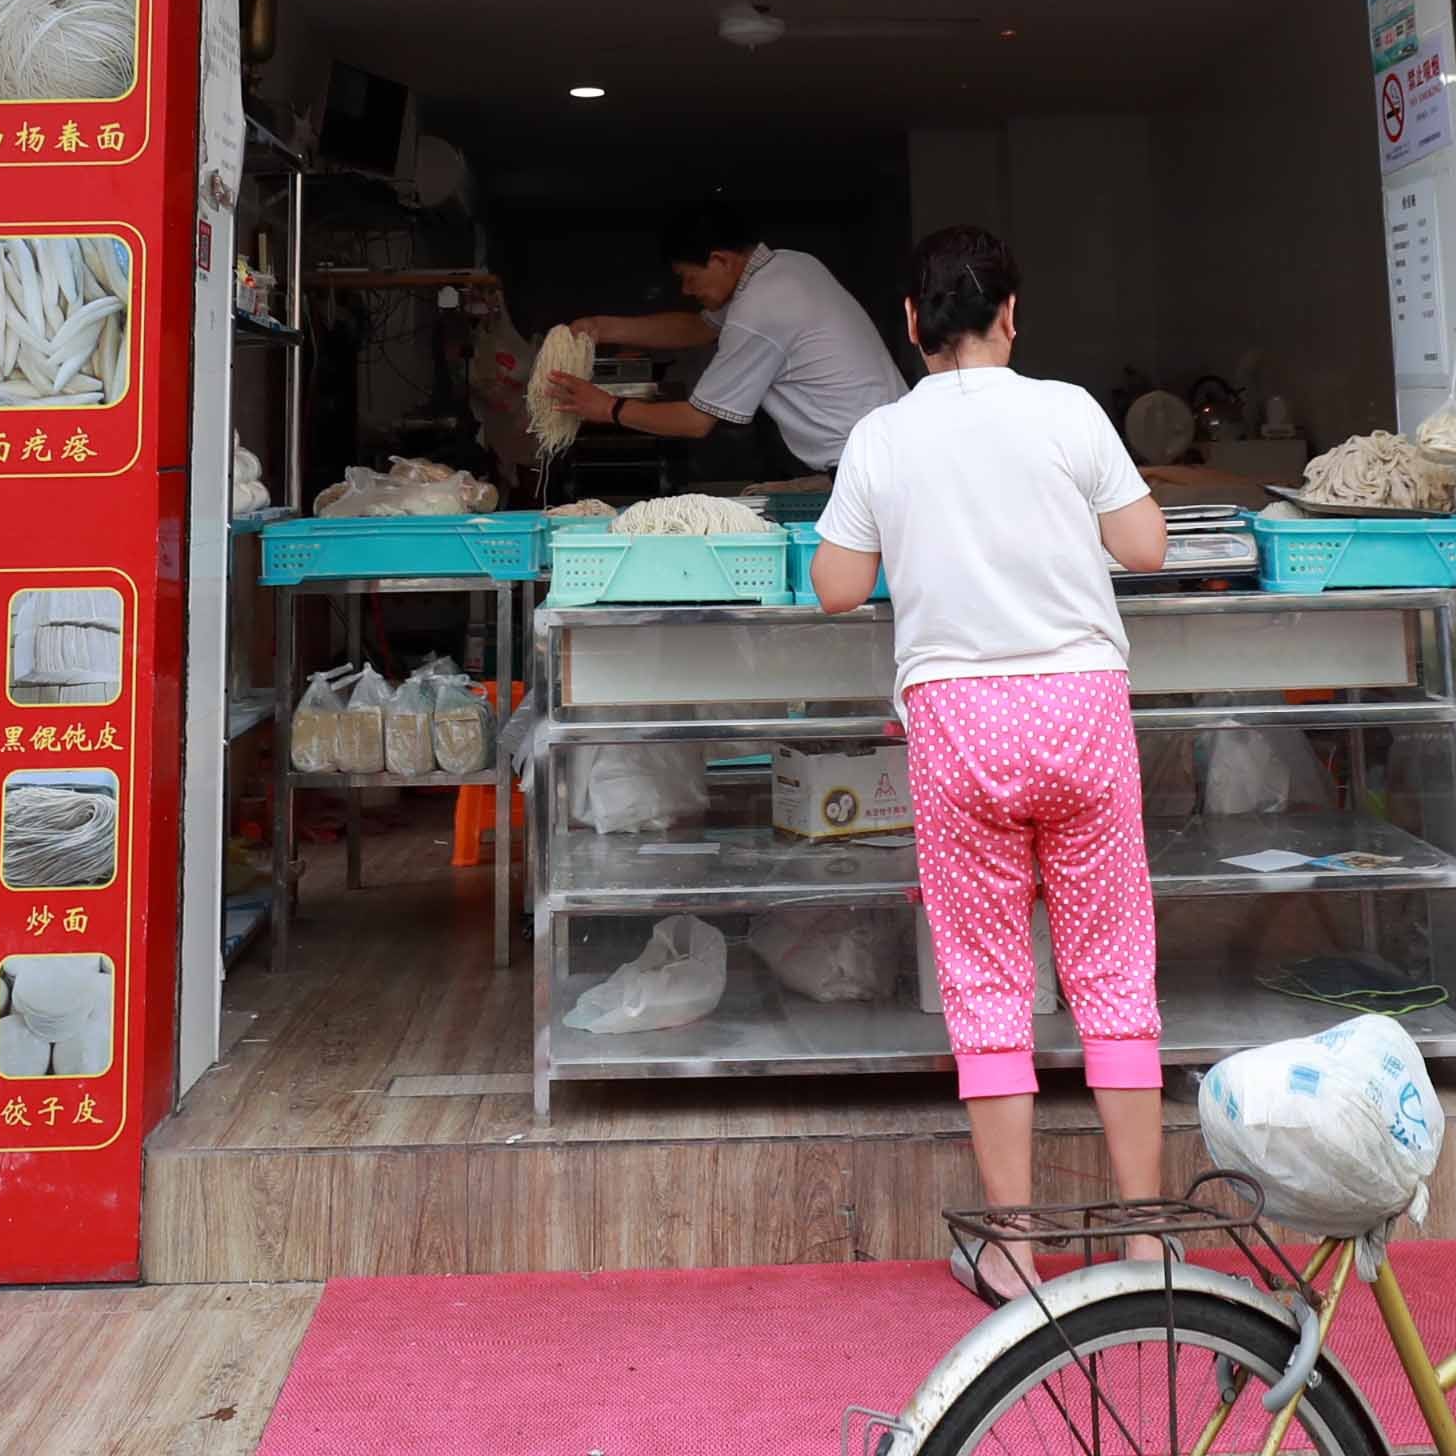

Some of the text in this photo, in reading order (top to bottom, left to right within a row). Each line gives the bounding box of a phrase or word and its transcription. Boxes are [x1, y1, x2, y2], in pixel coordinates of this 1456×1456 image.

[1, 722, 123, 752] 黑馄饨皮
[27, 905, 88, 935] 炒面
[1, 1094, 103, 1125] 饺子皮
